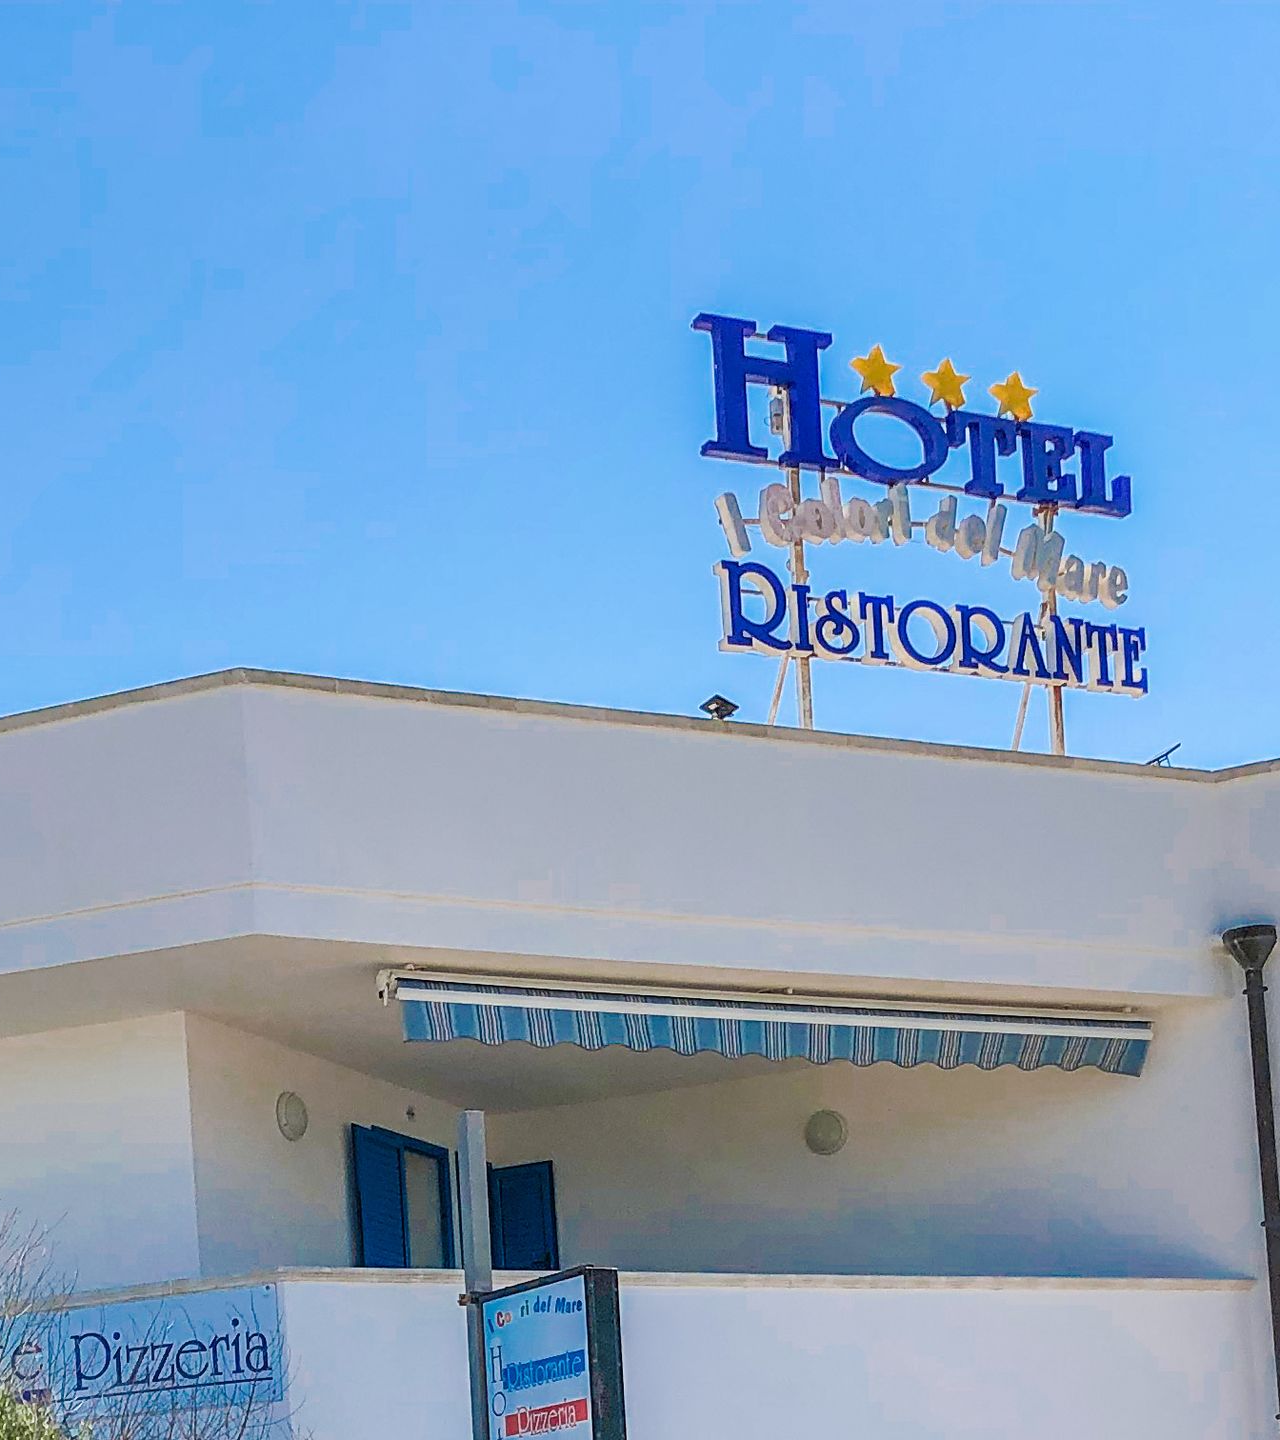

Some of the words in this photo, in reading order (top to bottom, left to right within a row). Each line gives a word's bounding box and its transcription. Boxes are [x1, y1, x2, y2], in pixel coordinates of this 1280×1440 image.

[691, 312, 1132, 518] HOTEL
[714, 493, 751, 557] I
[758, 478, 912, 546] Colori
[925, 495, 1008, 567] del
[1011, 524, 1129, 610] Mare
[713, 558, 1148, 697] RISTORANTE
[496, 1299, 529, 1328] Cori
[533, 1295, 552, 1313] del
[555, 1297, 583, 1314] Mare
[70, 1318, 272, 1391] Pizzeria
[506, 1352, 582, 1391] Ristorante
[517, 1398, 577, 1438] Pizzeria
